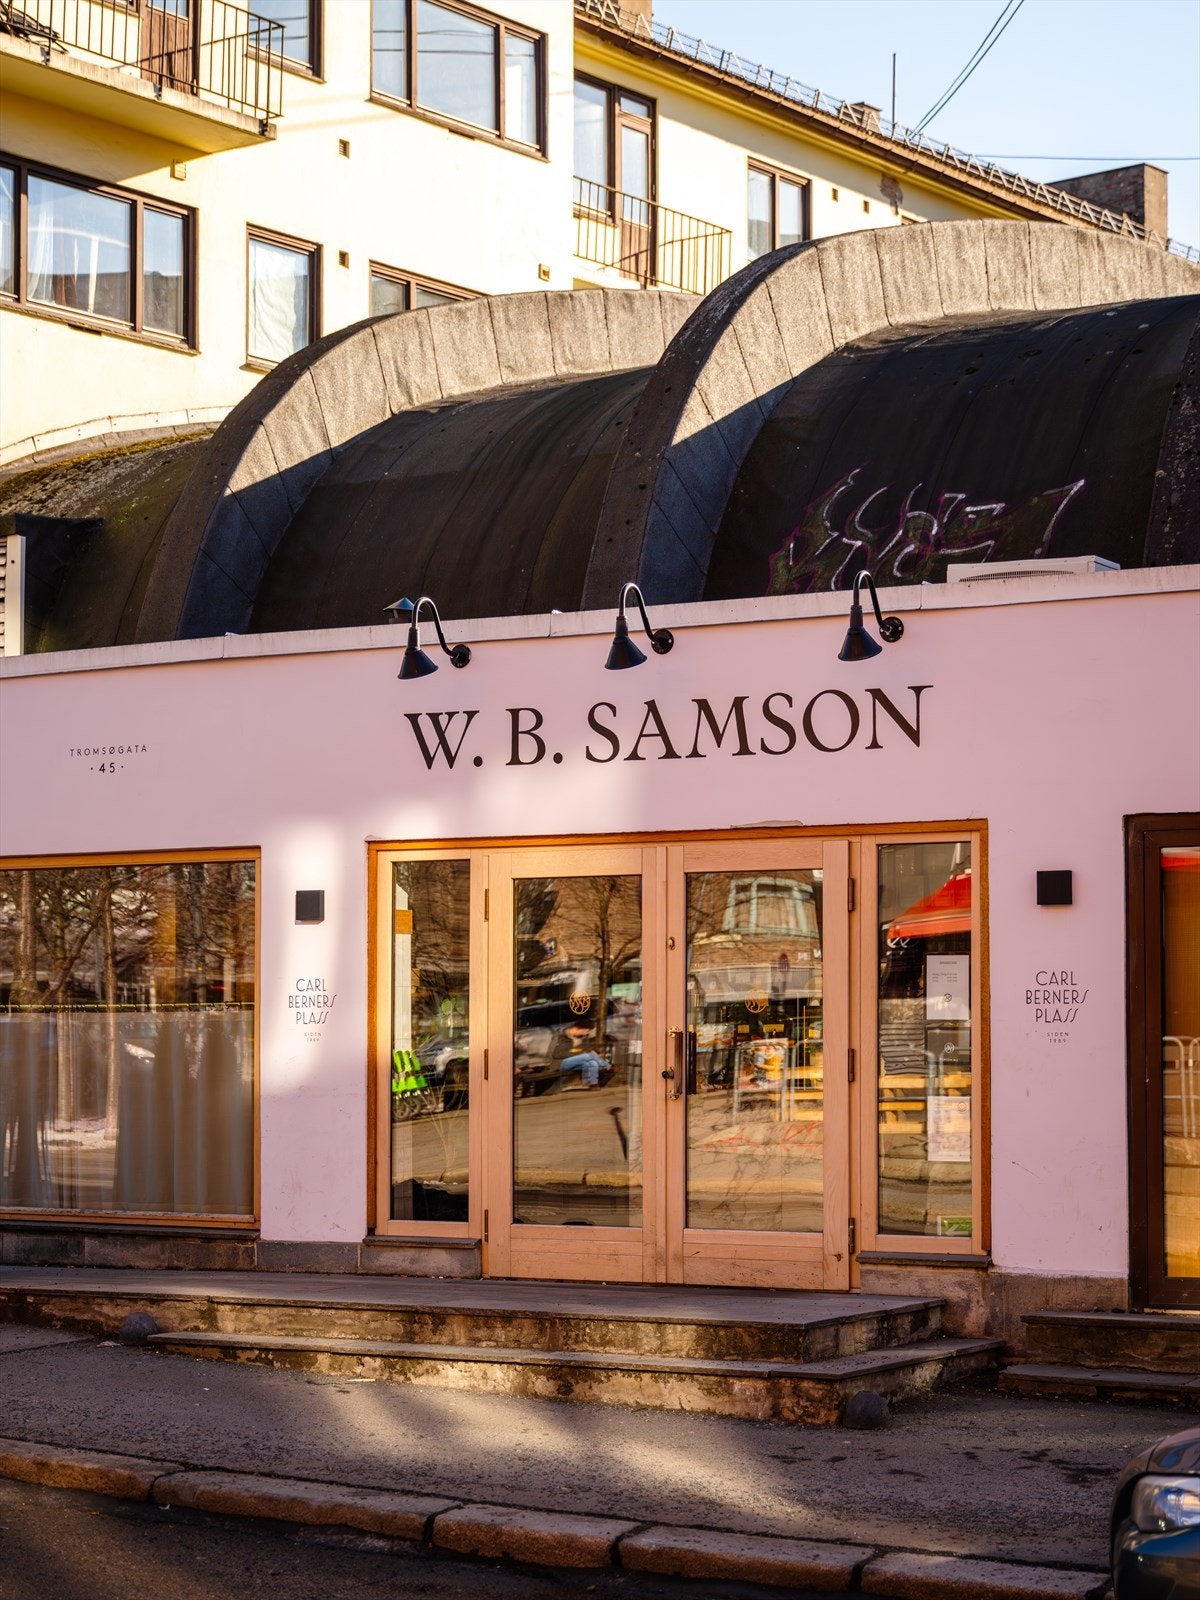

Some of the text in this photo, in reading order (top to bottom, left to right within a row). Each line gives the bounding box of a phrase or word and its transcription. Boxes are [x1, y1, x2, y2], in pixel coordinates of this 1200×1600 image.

[403, 684, 934, 770] W. B. SAMSON
[70, 745, 147, 757] TROMSØGATA
[295, 978, 327, 992] CARL
[1035, 970, 1077, 986] CARL
[288, 994, 337, 1009] BERNERS
[1025, 989, 1089, 1005] BERNERS
[295, 1011, 329, 1025] PLASS
[1035, 1008, 1079, 1024] PLASS
